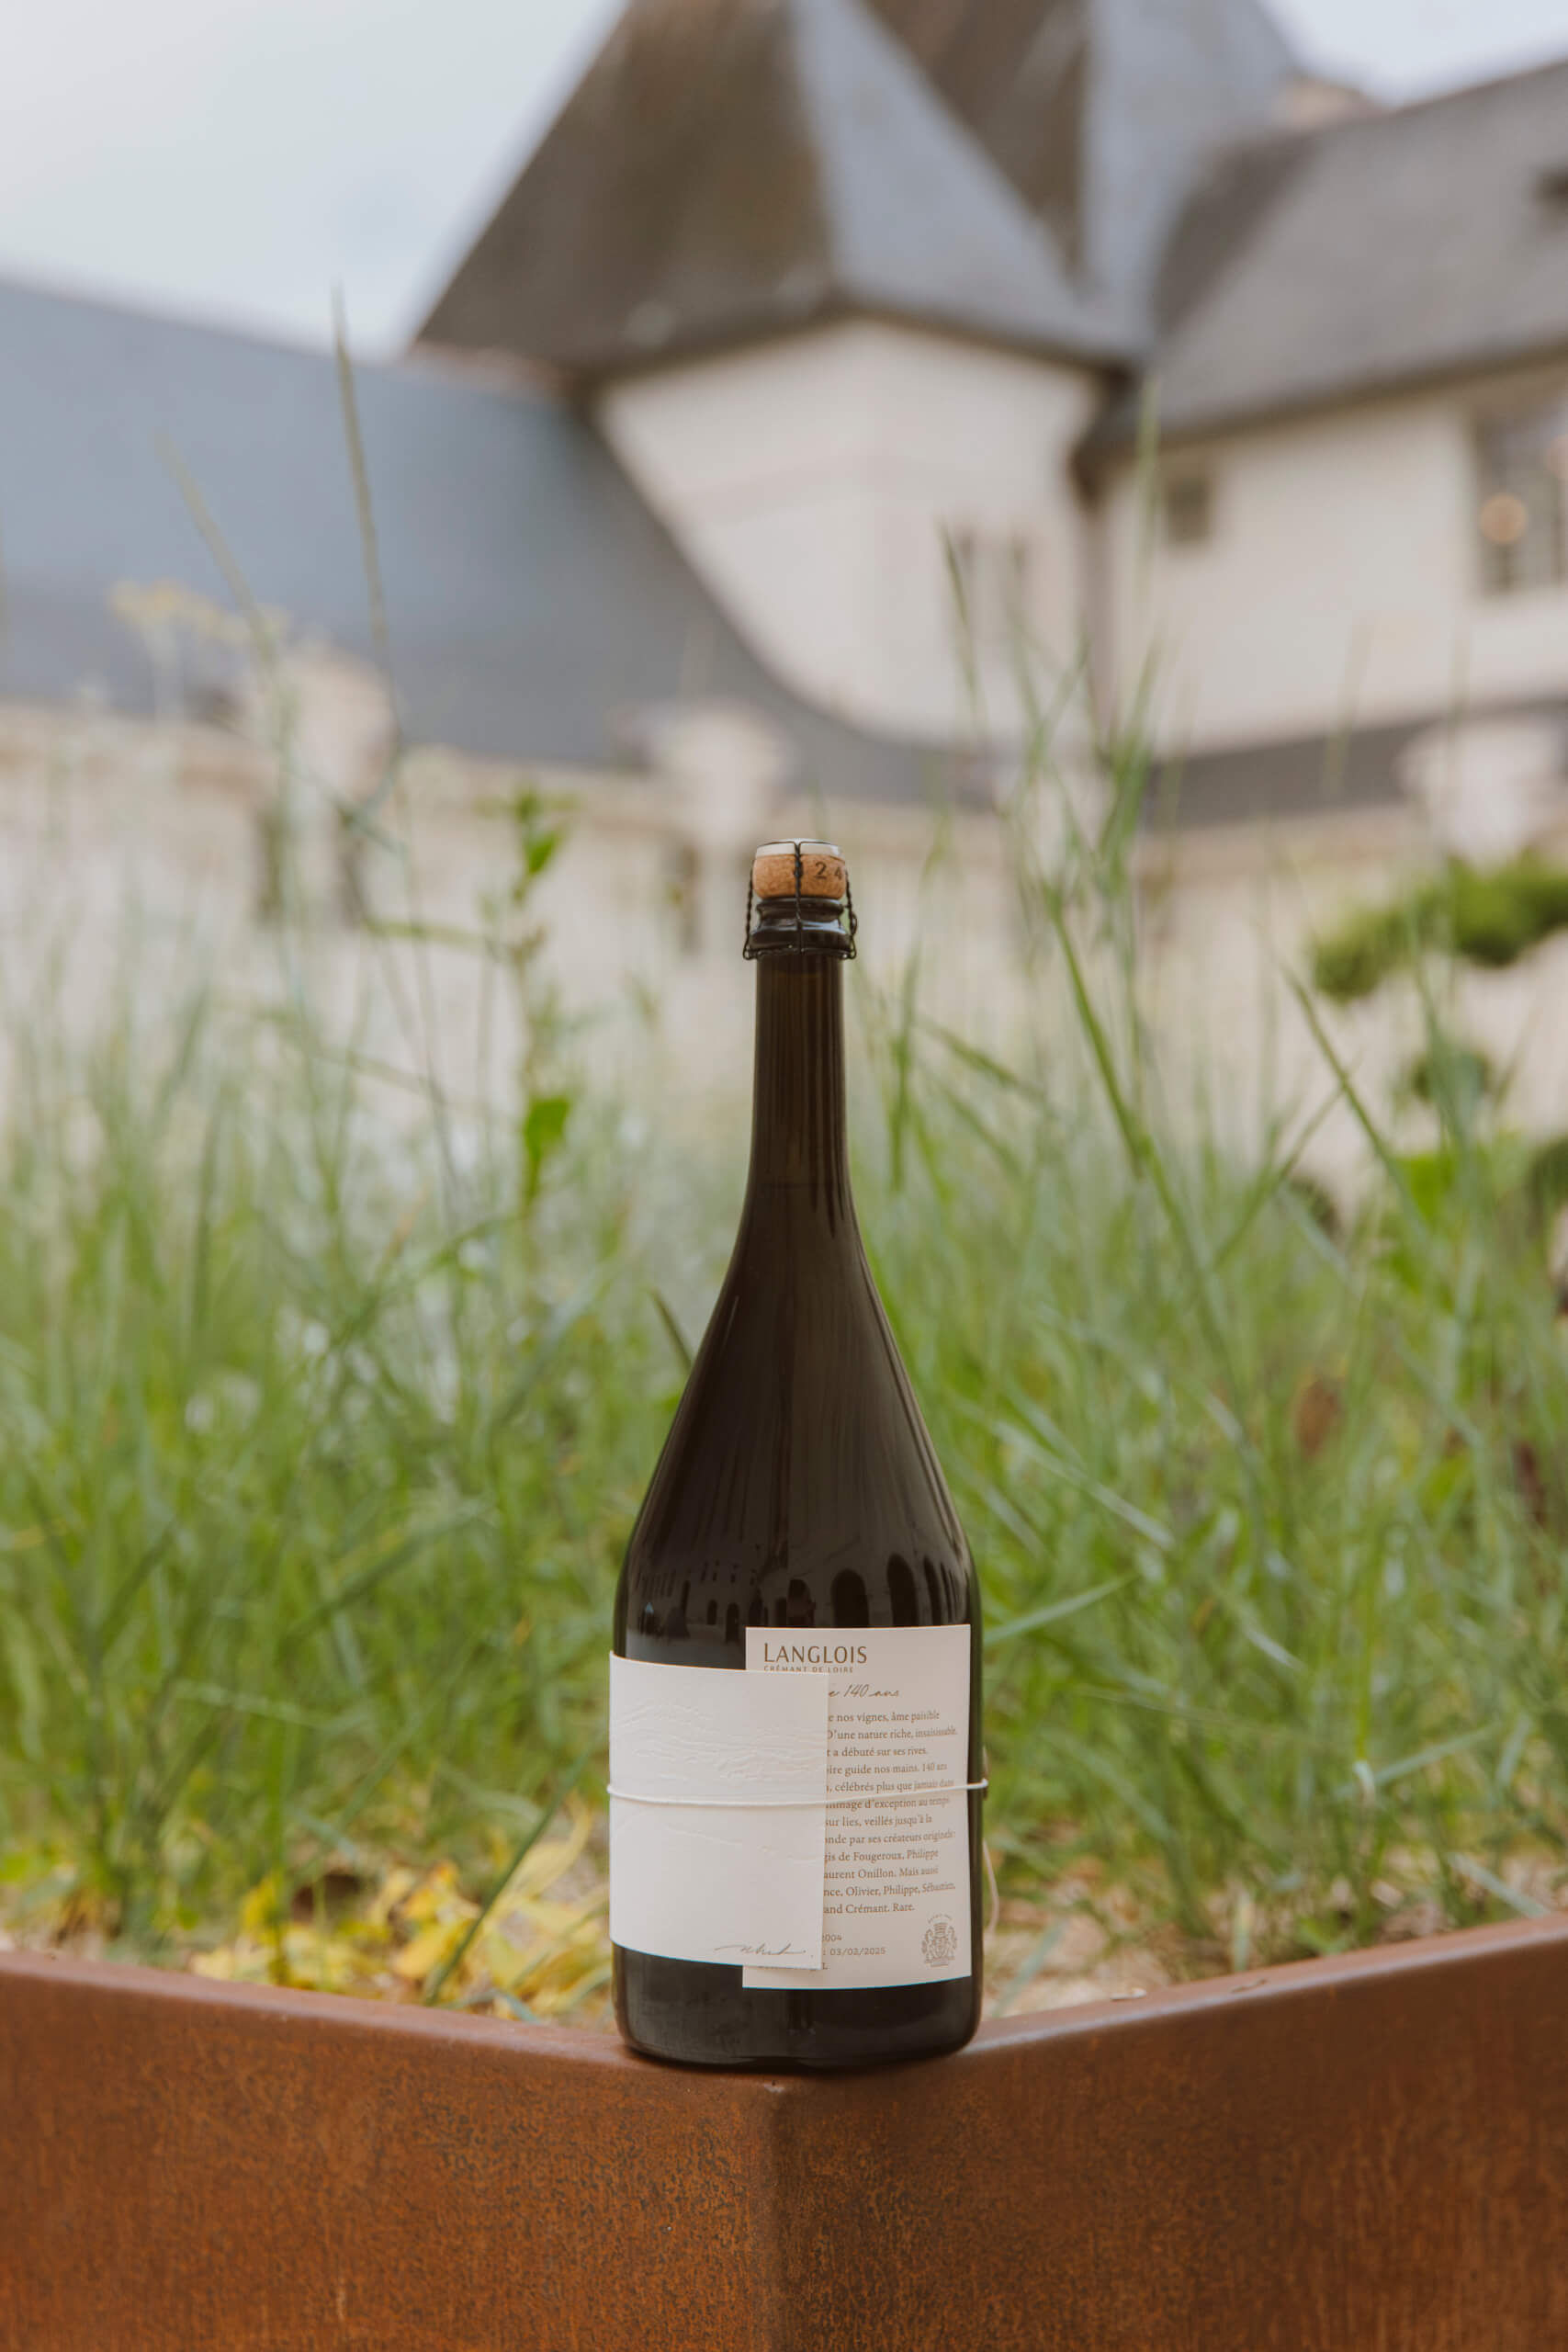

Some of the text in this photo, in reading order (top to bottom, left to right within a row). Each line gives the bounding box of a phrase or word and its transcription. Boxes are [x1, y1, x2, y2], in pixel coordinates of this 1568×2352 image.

[764, 1643, 867, 1664] LANGLOIS
[844, 1683, 870, 1698] 140
[870, 1690, 900, 1698] ans
[837, 1713, 854, 1722] nos
[891, 1712, 909, 1722] âme
[858, 1731, 888, 1739] nature
[890, 1727, 914, 1740] riche,
[841, 1747, 874, 1758] débuté
[876, 1748, 892, 1757] sur
[894, 1748, 906, 1757] ses
[845, 1764, 872, 1778] guide
[876, 1781, 895, 1793] plus
[897, 1782, 912, 1792] que
[850, 1837, 866, 1847] par
[868, 1836, 882, 1844] ses
[884, 1832, 922, 1843] créateurs
[839, 1852, 851, 1861] de
[907, 1849, 939, 1860] Philippe
[899, 1867, 919, 1877] Mais
